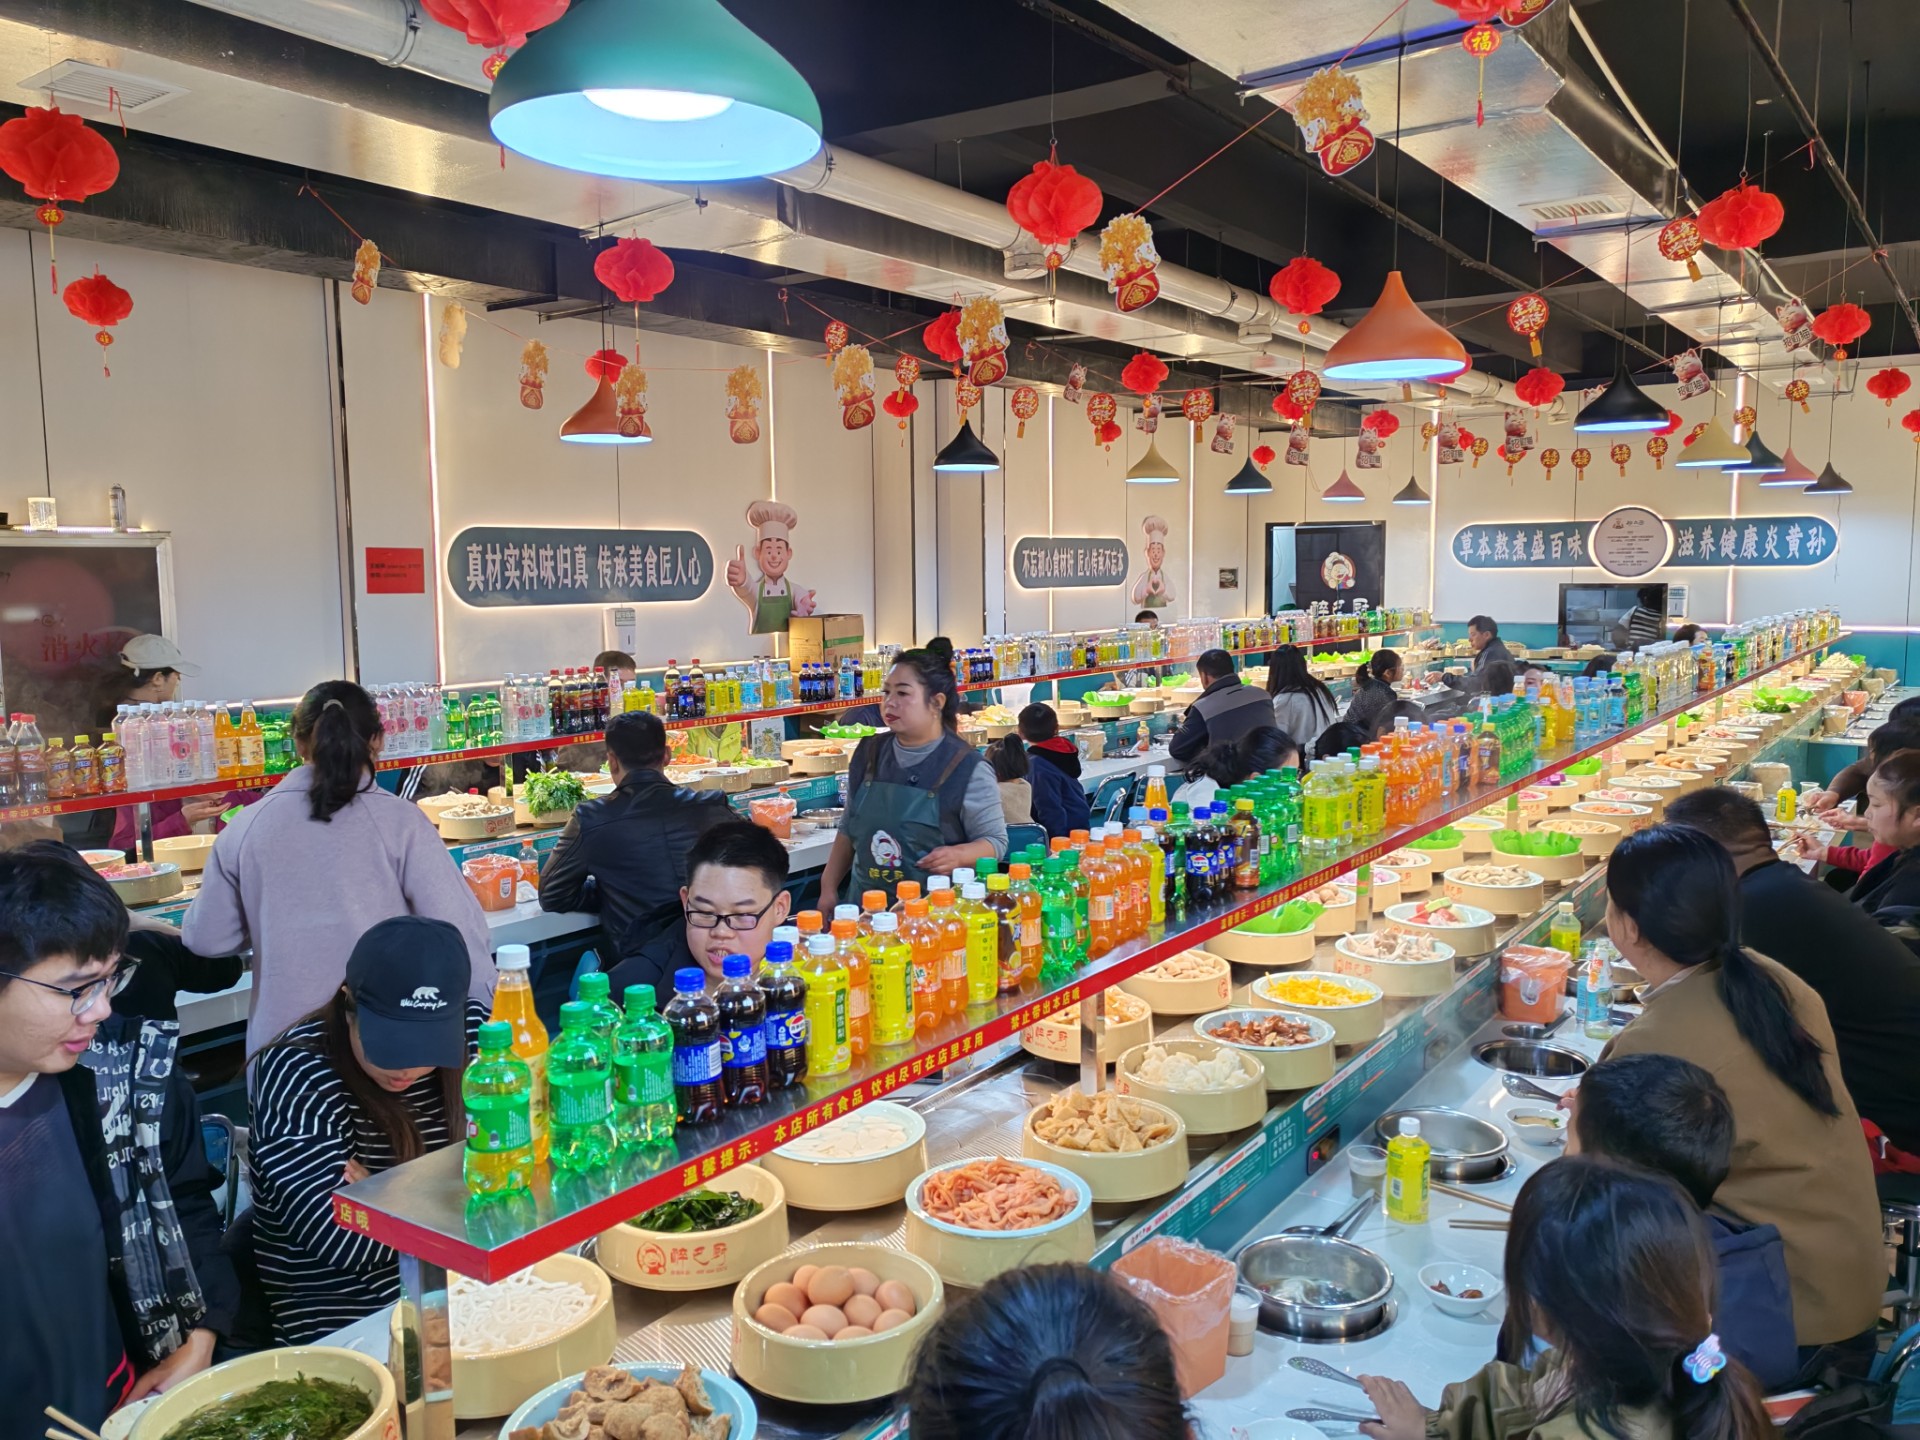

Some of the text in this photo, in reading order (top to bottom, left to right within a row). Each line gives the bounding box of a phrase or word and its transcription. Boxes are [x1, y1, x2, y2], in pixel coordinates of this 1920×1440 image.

[1471, 31, 1492, 52] 福
[43, 208, 60, 223] 福
[1459, 529, 1583, 562] 草本熬煮盛百味
[1677, 523, 1826, 561] 滋养健康炎黄孙
[466, 543, 701, 592] 真材实料味归真 传承美食匠人心
[1022, 546, 1124, 579] 不忘初心食材好 匠心传承不忘本
[773, 1088, 864, 1144] 本店所有食品
[870, 1031, 985, 1098] 饮料尽可在店里享用
[1009, 987, 1081, 1031] 禁止带出本店哦
[333, 1201, 371, 1233] 店哦
